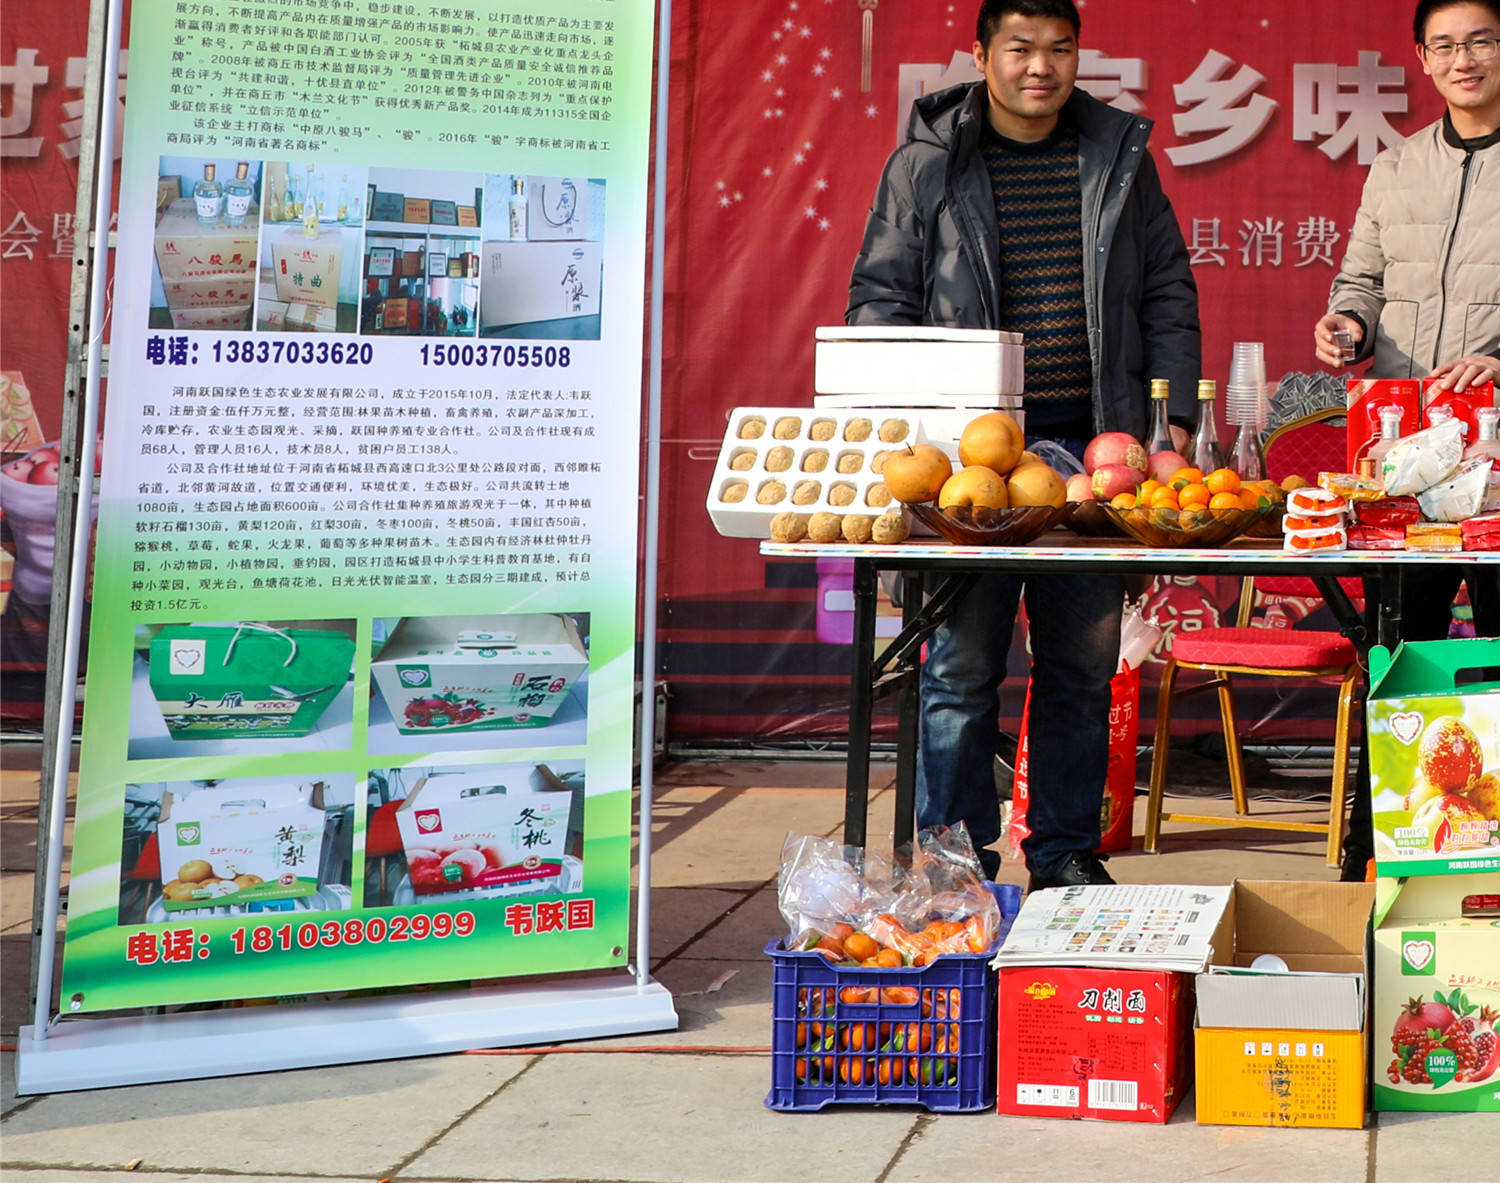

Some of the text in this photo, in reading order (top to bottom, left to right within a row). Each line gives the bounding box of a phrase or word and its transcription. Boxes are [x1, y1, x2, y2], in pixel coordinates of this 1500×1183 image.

[146, 336, 571, 369] 电话：13837033620 15003705508
[127, 899, 596, 966] 电话：18103802999 韦跃国
[1078, 988, 1147, 1014] 刀削面
[1428, 1055, 1456, 1067] 100%
